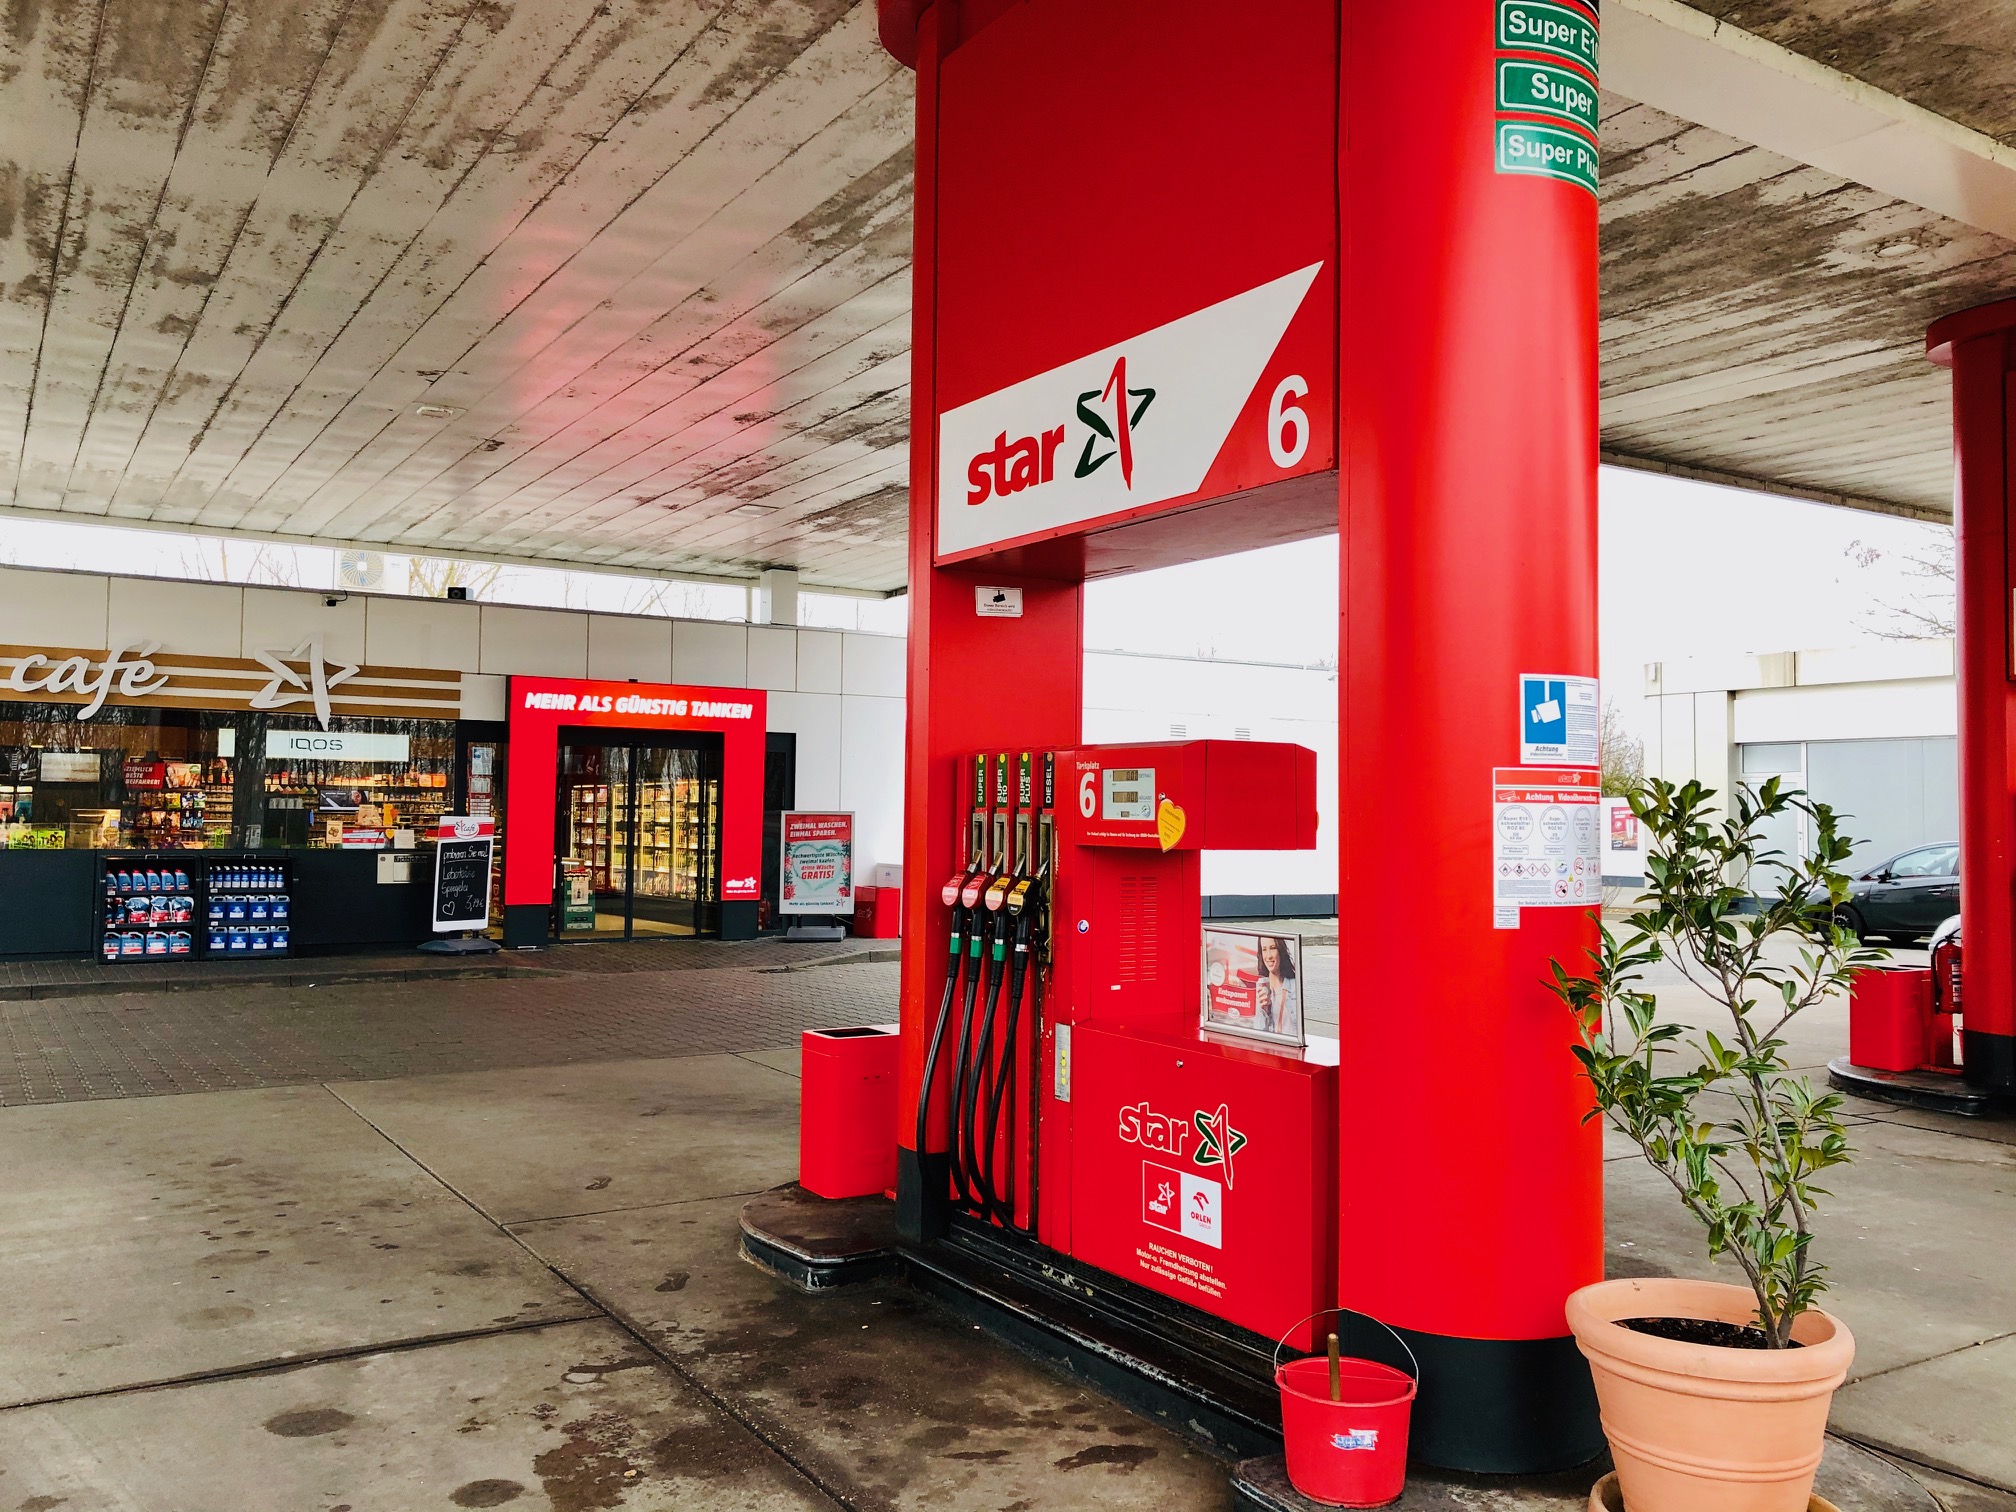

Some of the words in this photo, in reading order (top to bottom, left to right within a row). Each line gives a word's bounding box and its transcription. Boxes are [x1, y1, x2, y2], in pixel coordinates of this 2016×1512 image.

[1508, 10, 1577, 46] Super
[1531, 73, 1592, 116] Super
[1508, 135, 1573, 165] Super
[1267, 374, 1310, 469] 6
[967, 424, 1065, 505] star
[10, 639, 169, 720] café
[525, 692, 577, 711] MEHR
[578, 695, 613, 713] ALS
[615, 694, 688, 717] GÜNSTIG
[691, 701, 753, 720] TANKEN
[290, 738, 343, 751] IQOS
[1535, 745, 1559, 753] Achtung
[1080, 771, 1096, 818] 6
[1525, 793, 1554, 802] Achtung
[802, 870, 835, 880] GRATIS!
[1218, 987, 1248, 999] Entspannt
[1119, 1102, 1188, 1156] star
[1148, 1200, 1168, 1215] star
[1190, 1212, 1212, 1225] ORLEN
[1140, 1259, 1150, 1270] Nur
[1150, 1264, 1176, 1280] zulässige
[1148, 1242, 1178, 1260] RAUCHEN
[1178, 1252, 1213, 1274] VERBOTEN!
[1160, 1256, 1198, 1280] Fremdheizung
[1199, 1273, 1227, 1290] abstellen.
